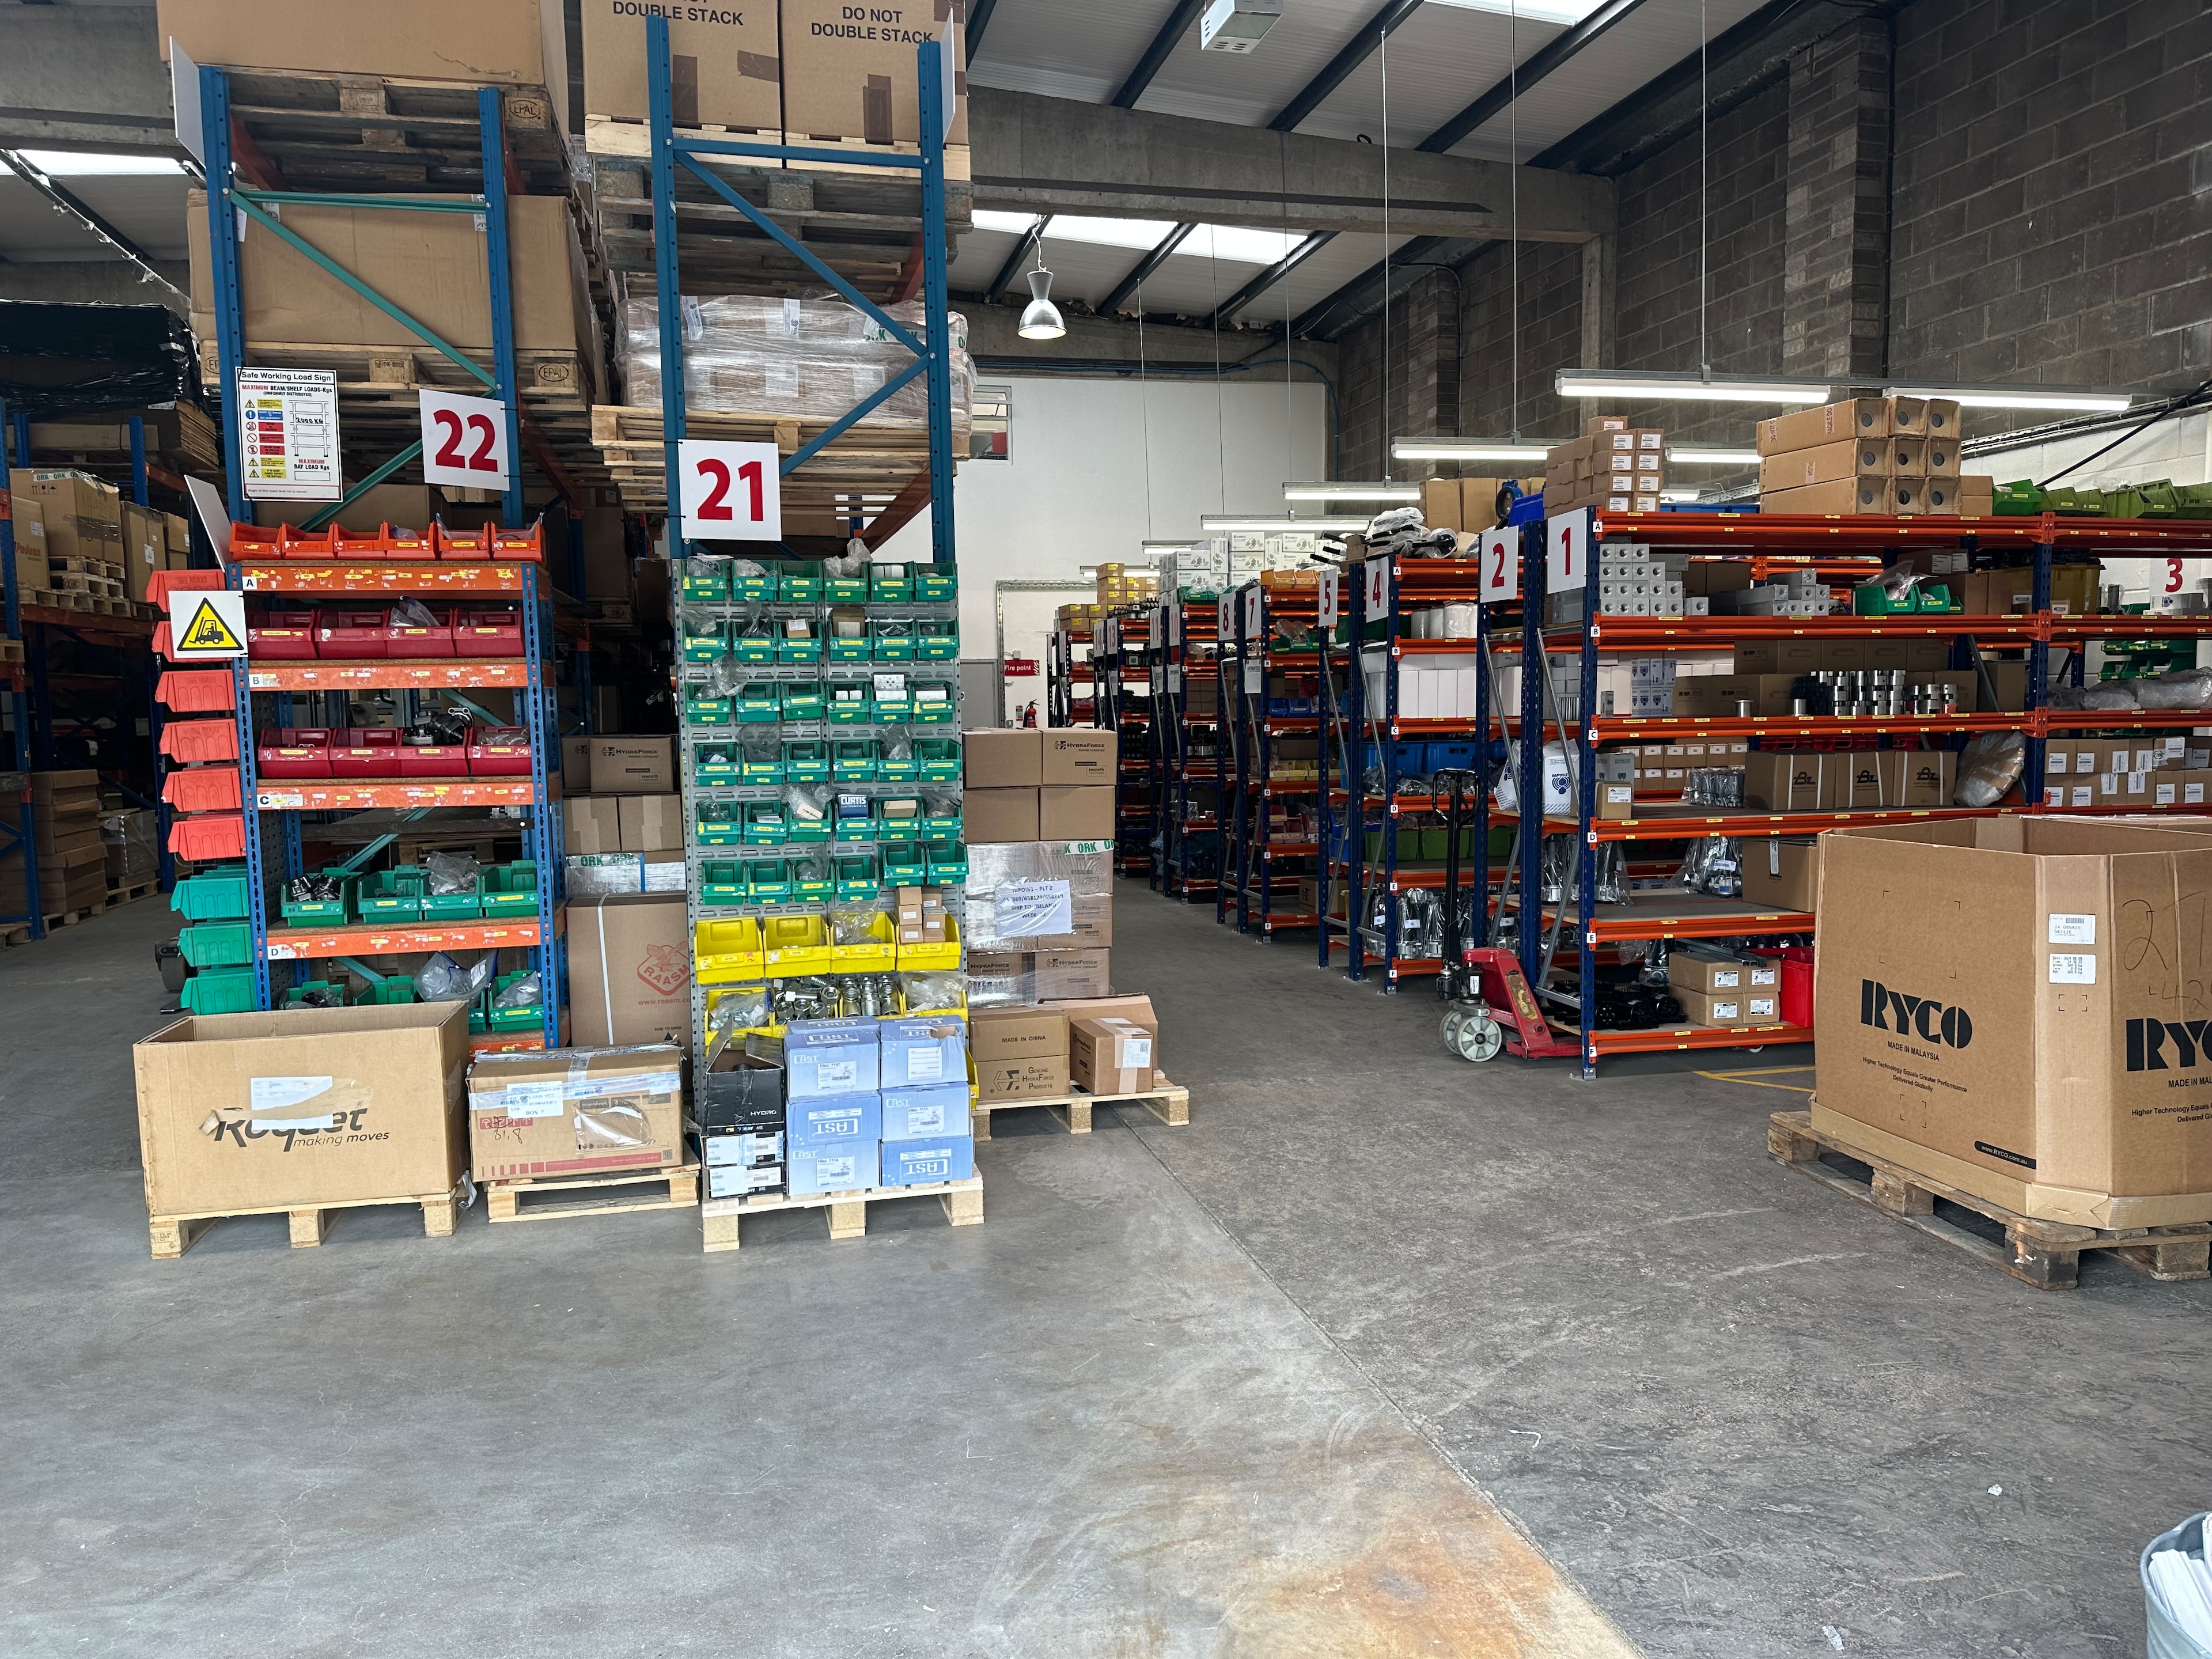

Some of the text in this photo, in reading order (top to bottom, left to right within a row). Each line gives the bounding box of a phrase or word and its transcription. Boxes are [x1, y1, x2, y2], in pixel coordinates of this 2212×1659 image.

[613, 1, 744, 25] DOUBLE STACK
[843, 6, 902, 24] DO NOT
[812, 22, 933, 44] DOUBLE STACK
[260, 373, 291, 381] Working
[548, 366, 566, 378] EPAL
[434, 410, 497, 471] 22
[698, 459, 763, 521] 21
[1562, 528, 1570, 574] 1
[1492, 544, 1504, 587] 2
[2166, 558, 2183, 592] 3
[1324, 580, 1331, 615] 5
[1372, 571, 1381, 608] 4
[1223, 604, 1229, 631] 8
[1249, 598, 1255, 628] 7
[1152, 613, 1161, 643] 11
[1171, 610, 1180, 638] 10
[1108, 623, 1118, 650] 13
[1017, 665, 1031, 673] point
[260, 796, 268, 804] C
[840, 797, 866, 805] CURTIS
[1078, 843, 1097, 853] ORK
[581, 856, 603, 866] ORK
[644, 964, 690, 985] RAASM
[638, 997, 691, 1005] www.raasm.co
[1861, 979, 1972, 1049] RYCO
[794, 1055, 819, 1064] CAST
[1888, 1041, 1903, 1051] MADE
[1911, 1048, 1939, 1061] MALAYSIA
[1862, 1056, 1967, 1093] Higher Technology Equals Greater Performance
[1893, 1074, 1933, 1093] Delivered Globally
[886, 1099, 910, 1108] CAST
[2132, 1107, 2152, 1116] Higher
[2154, 1106, 2190, 1115] Technology
[813, 1118, 858, 1135] CAST
[293, 1132, 389, 1147] making moves
[793, 1150, 818, 1160] CAST
[1981, 1145, 2028, 1165] www.RYCO.com.au
[904, 1159, 948, 1176] CAST
